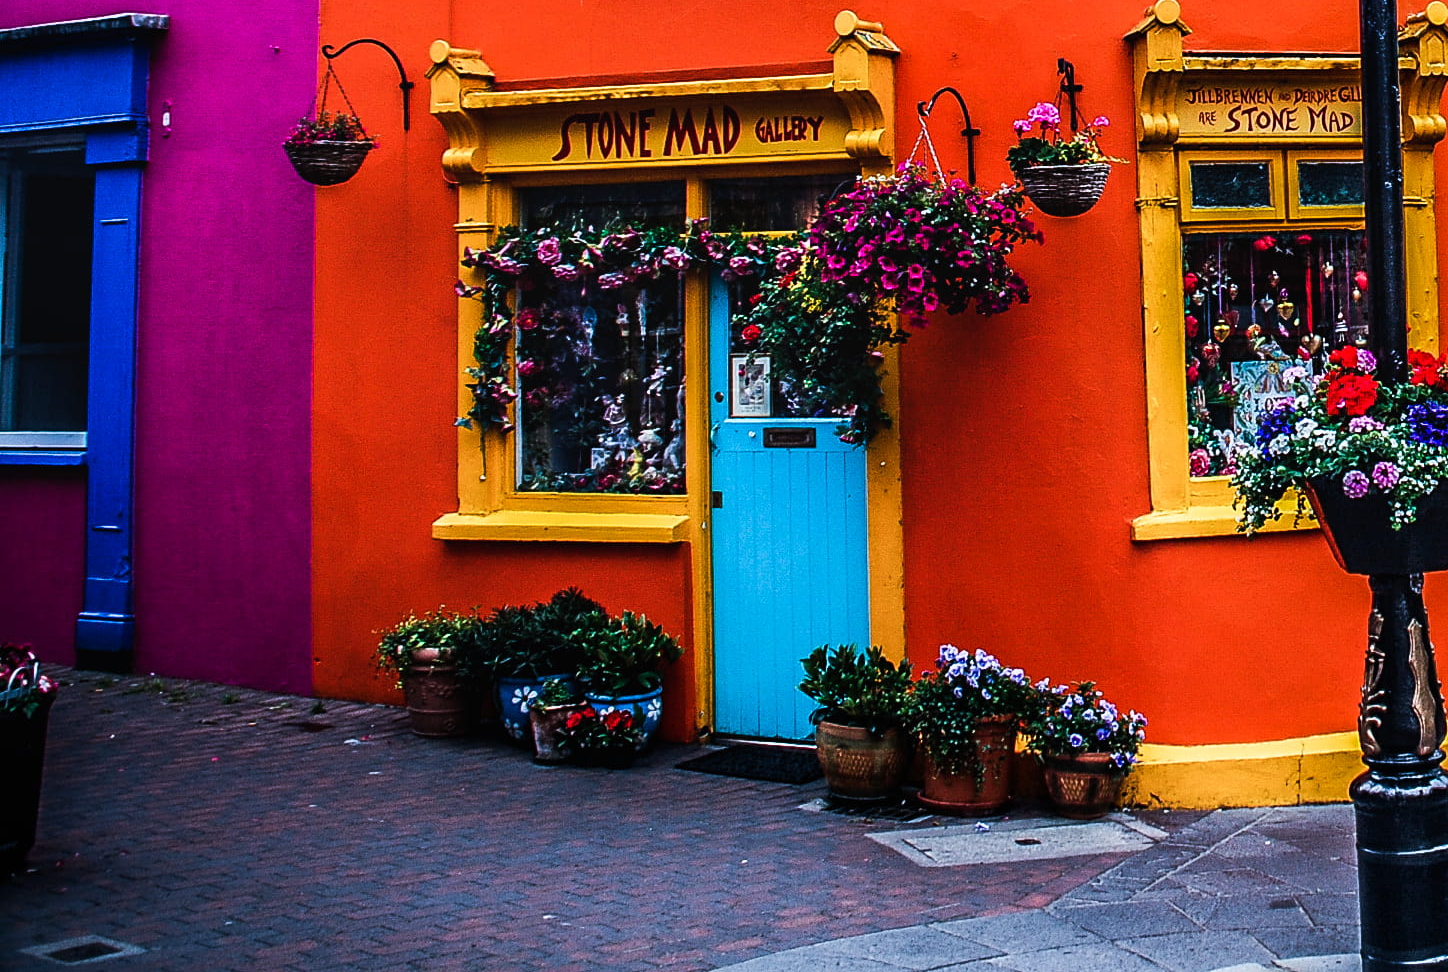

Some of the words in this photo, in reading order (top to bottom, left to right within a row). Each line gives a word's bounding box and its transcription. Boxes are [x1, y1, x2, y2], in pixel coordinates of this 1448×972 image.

[1293, 88, 1338, 106] DEIRDRE
[1198, 111, 1217, 126] ARE
[1224, 105, 1300, 132] STONE
[1307, 105, 1354, 133] MAD
[552, 107, 655, 162] STONE
[663, 105, 741, 157] MAD
[755, 115, 824, 144] GALLERY
